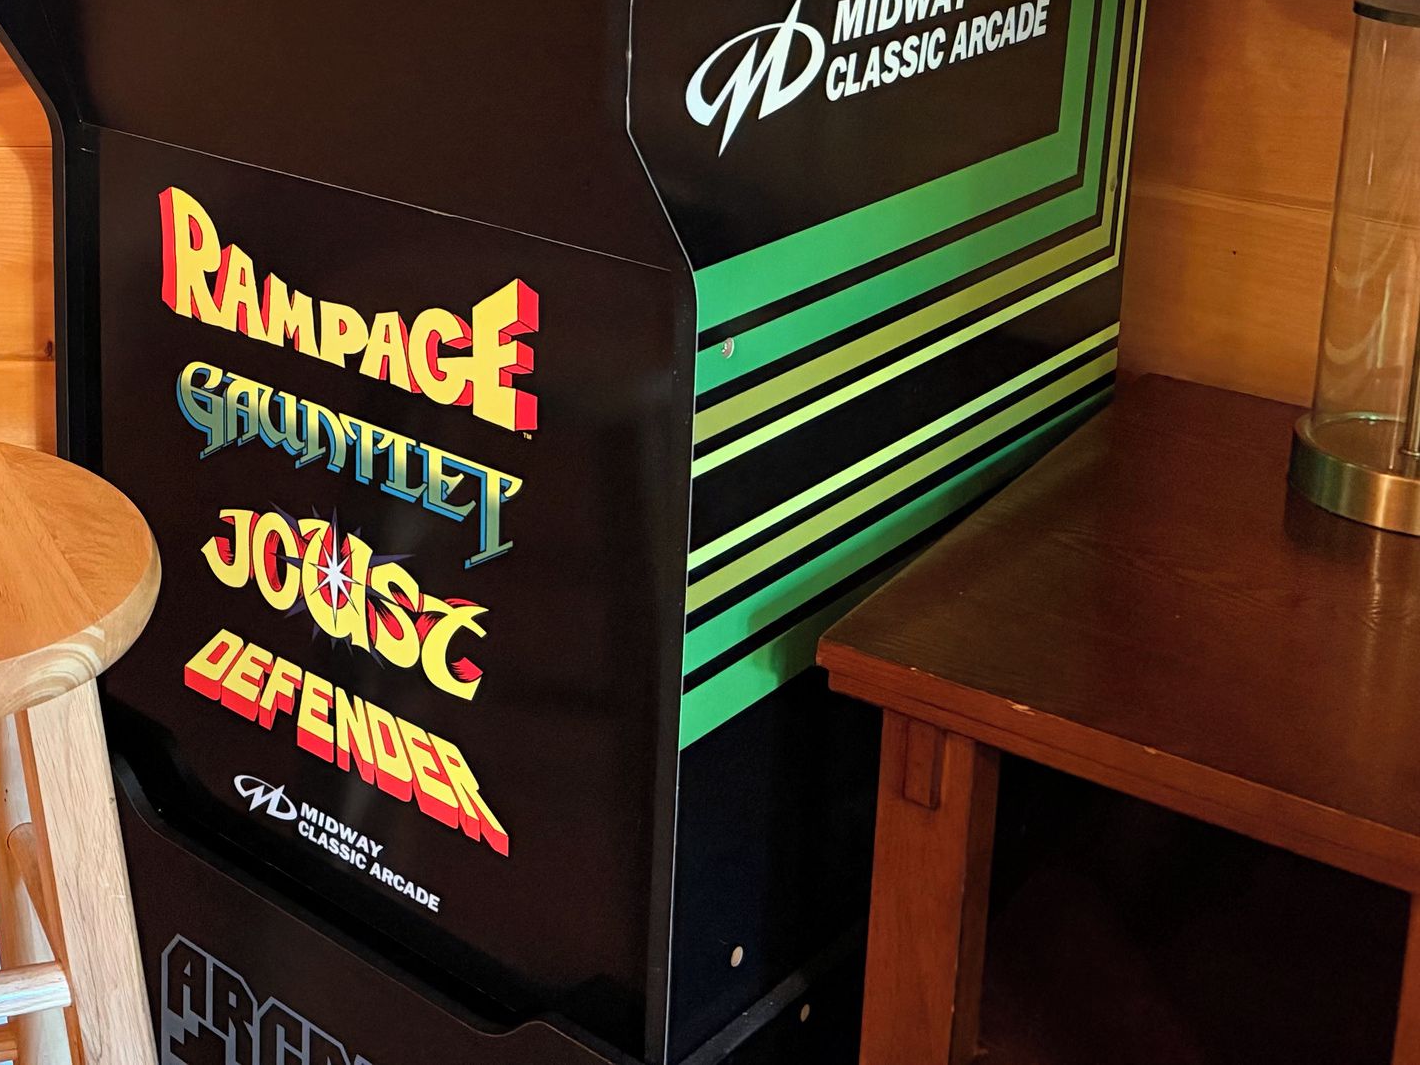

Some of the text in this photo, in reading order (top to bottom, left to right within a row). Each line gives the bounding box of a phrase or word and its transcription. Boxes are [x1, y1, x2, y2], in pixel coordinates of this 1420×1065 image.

[825, 27, 946, 102] CLASSIC
[158, 186, 539, 433] RAMPAGE
[176, 361, 523, 569] GAUNTLET
[201, 508, 489, 701] JOUST
[184, 628, 509, 858] DEFENDER
[299, 802, 384, 859] MIDWAY
[298, 820, 441, 913] CLASSIC ARCADE
